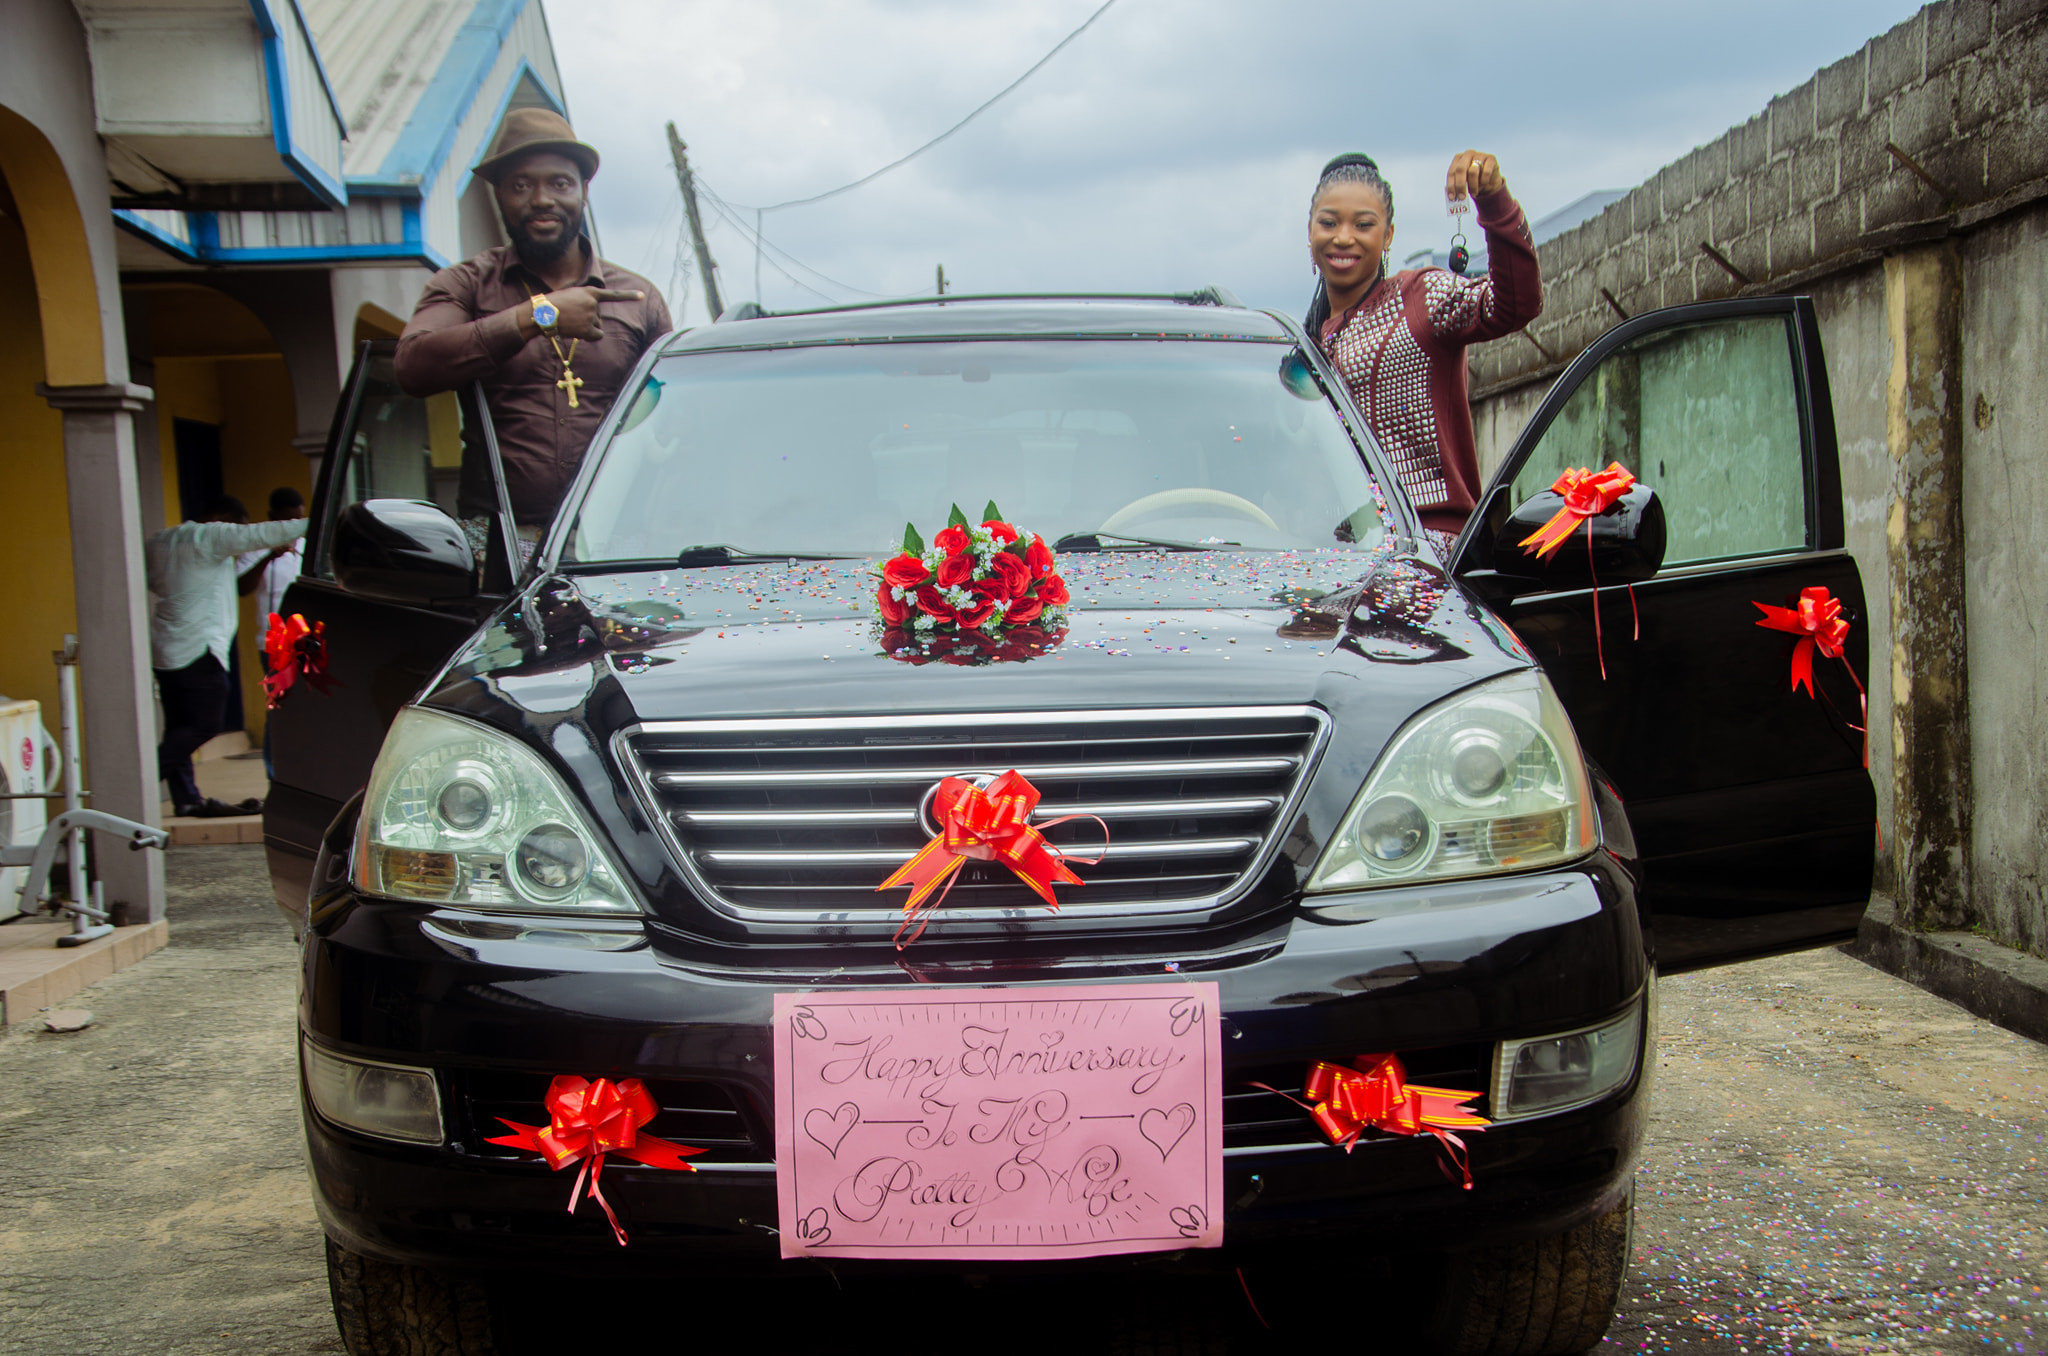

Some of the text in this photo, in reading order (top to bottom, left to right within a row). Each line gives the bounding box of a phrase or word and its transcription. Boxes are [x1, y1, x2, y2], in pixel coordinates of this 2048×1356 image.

[821, 1026, 1186, 1099] Happy Anniversary
[906, 1089, 1071, 1165] To My
[833, 1144, 1132, 1228] Pretty Wife
